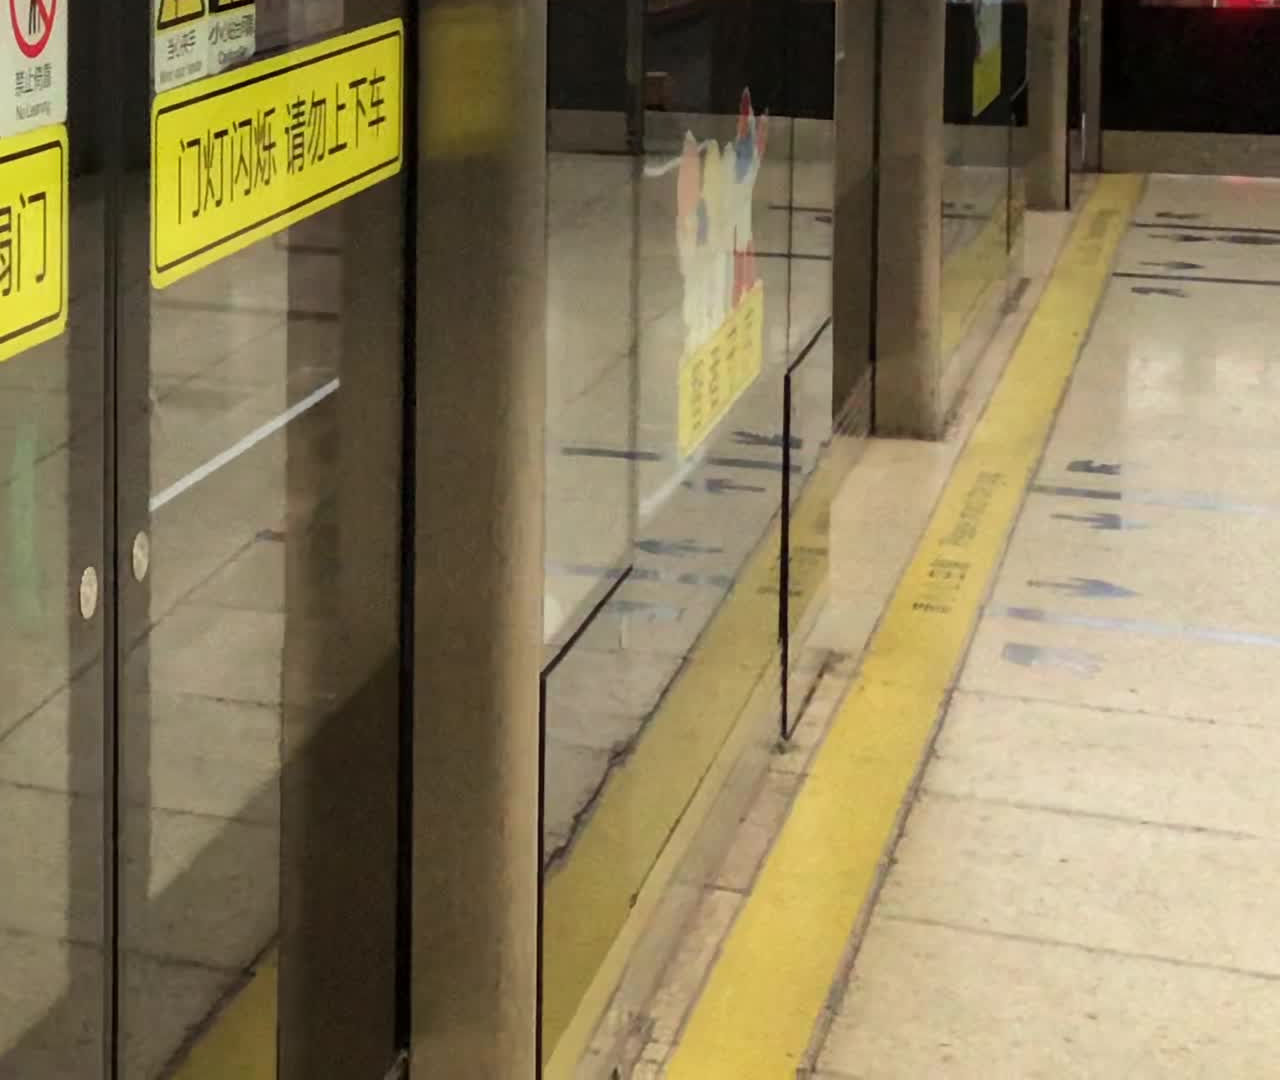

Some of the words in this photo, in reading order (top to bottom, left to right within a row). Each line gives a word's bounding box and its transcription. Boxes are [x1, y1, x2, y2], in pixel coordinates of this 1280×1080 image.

[177, 107, 277, 225] 门灯闪烁
[285, 67, 387, 175] 请勿上下车
